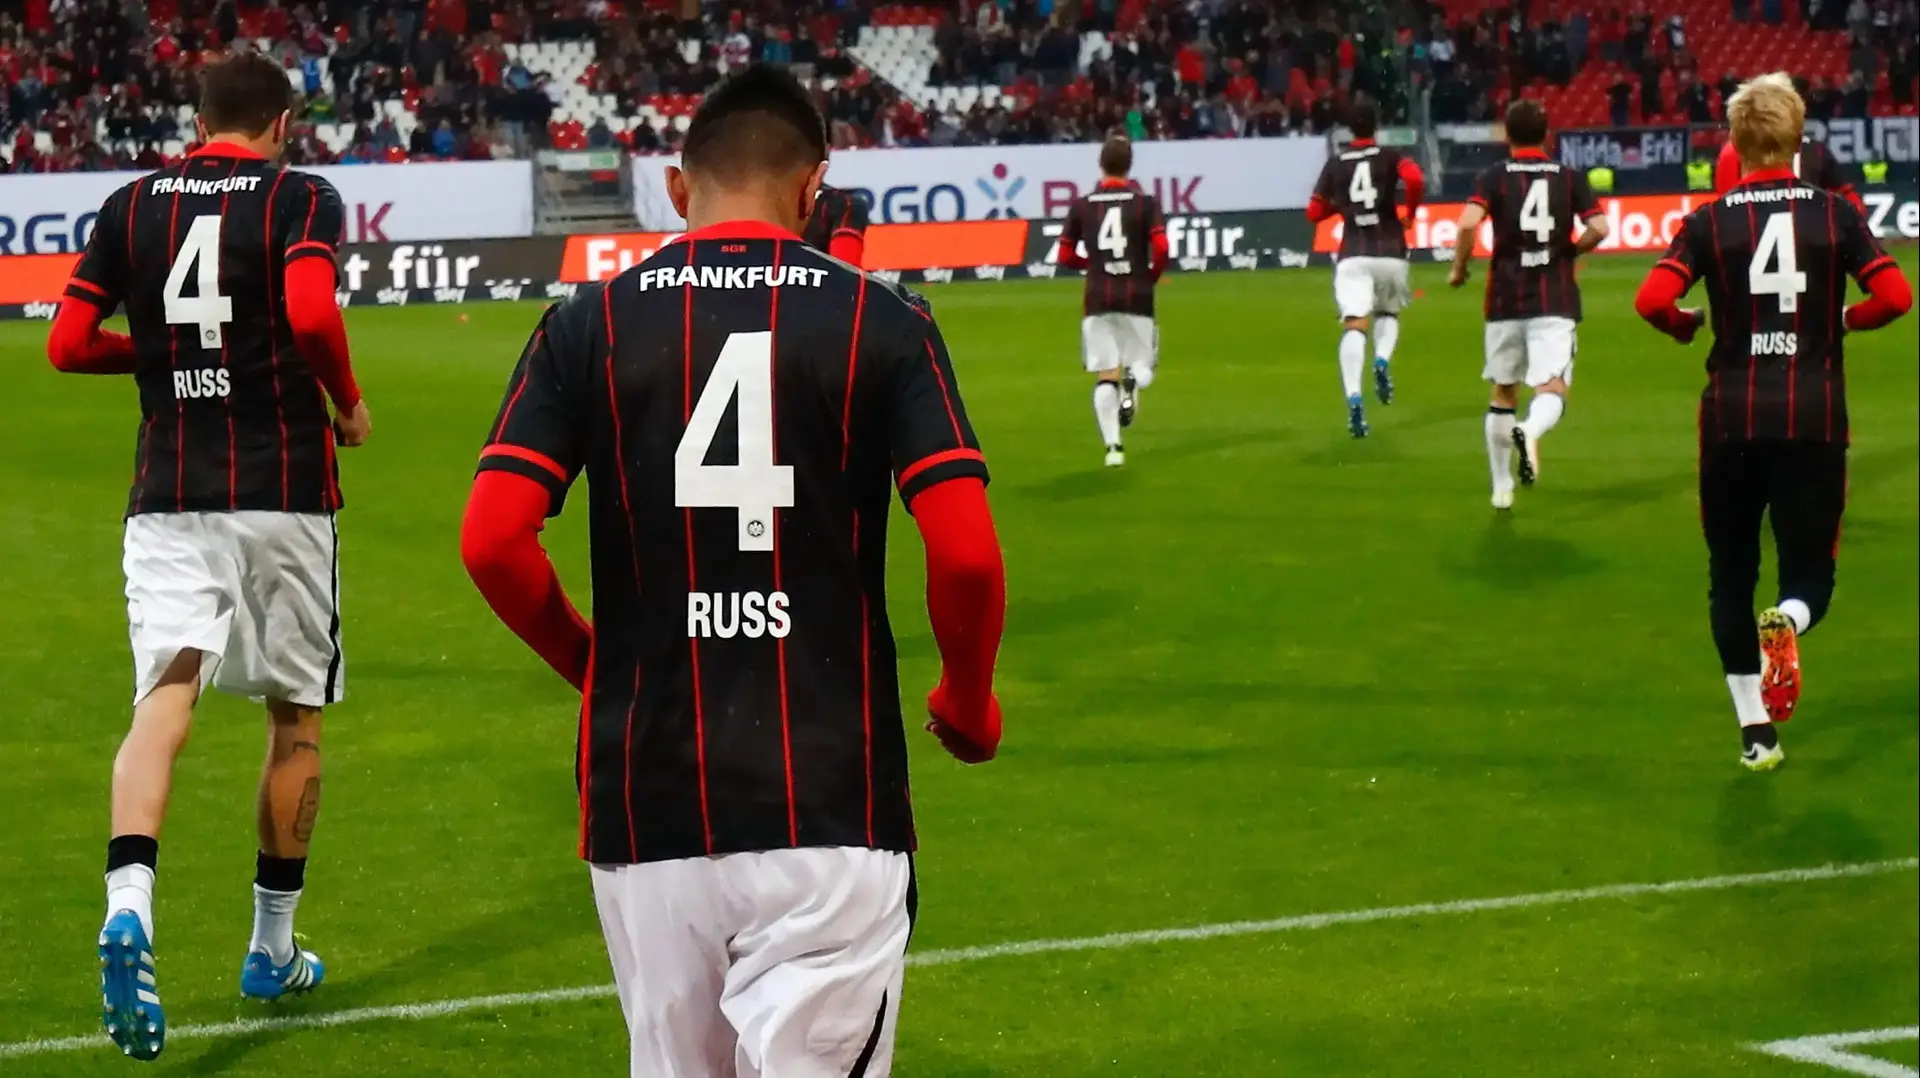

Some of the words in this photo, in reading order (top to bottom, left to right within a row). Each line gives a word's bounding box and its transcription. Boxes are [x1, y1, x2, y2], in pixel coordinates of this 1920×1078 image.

[151, 176, 261, 196] FRANKFURT
[1349, 161, 1378, 210] 4
[1726, 187, 1815, 208] FRANKFURT
[1097, 206, 1128, 259] 4
[1520, 178, 1556, 243] 4
[163, 214, 233, 349] 4
[638, 265, 829, 292] FRANKFURT
[1749, 211, 1807, 314] 4
[22, 300, 58, 320] sky
[1750, 331, 1797, 356] RUSS
[173, 368, 231, 399] RUSS
[674, 331, 794, 551] 4
[687, 591, 791, 638] RUSS
